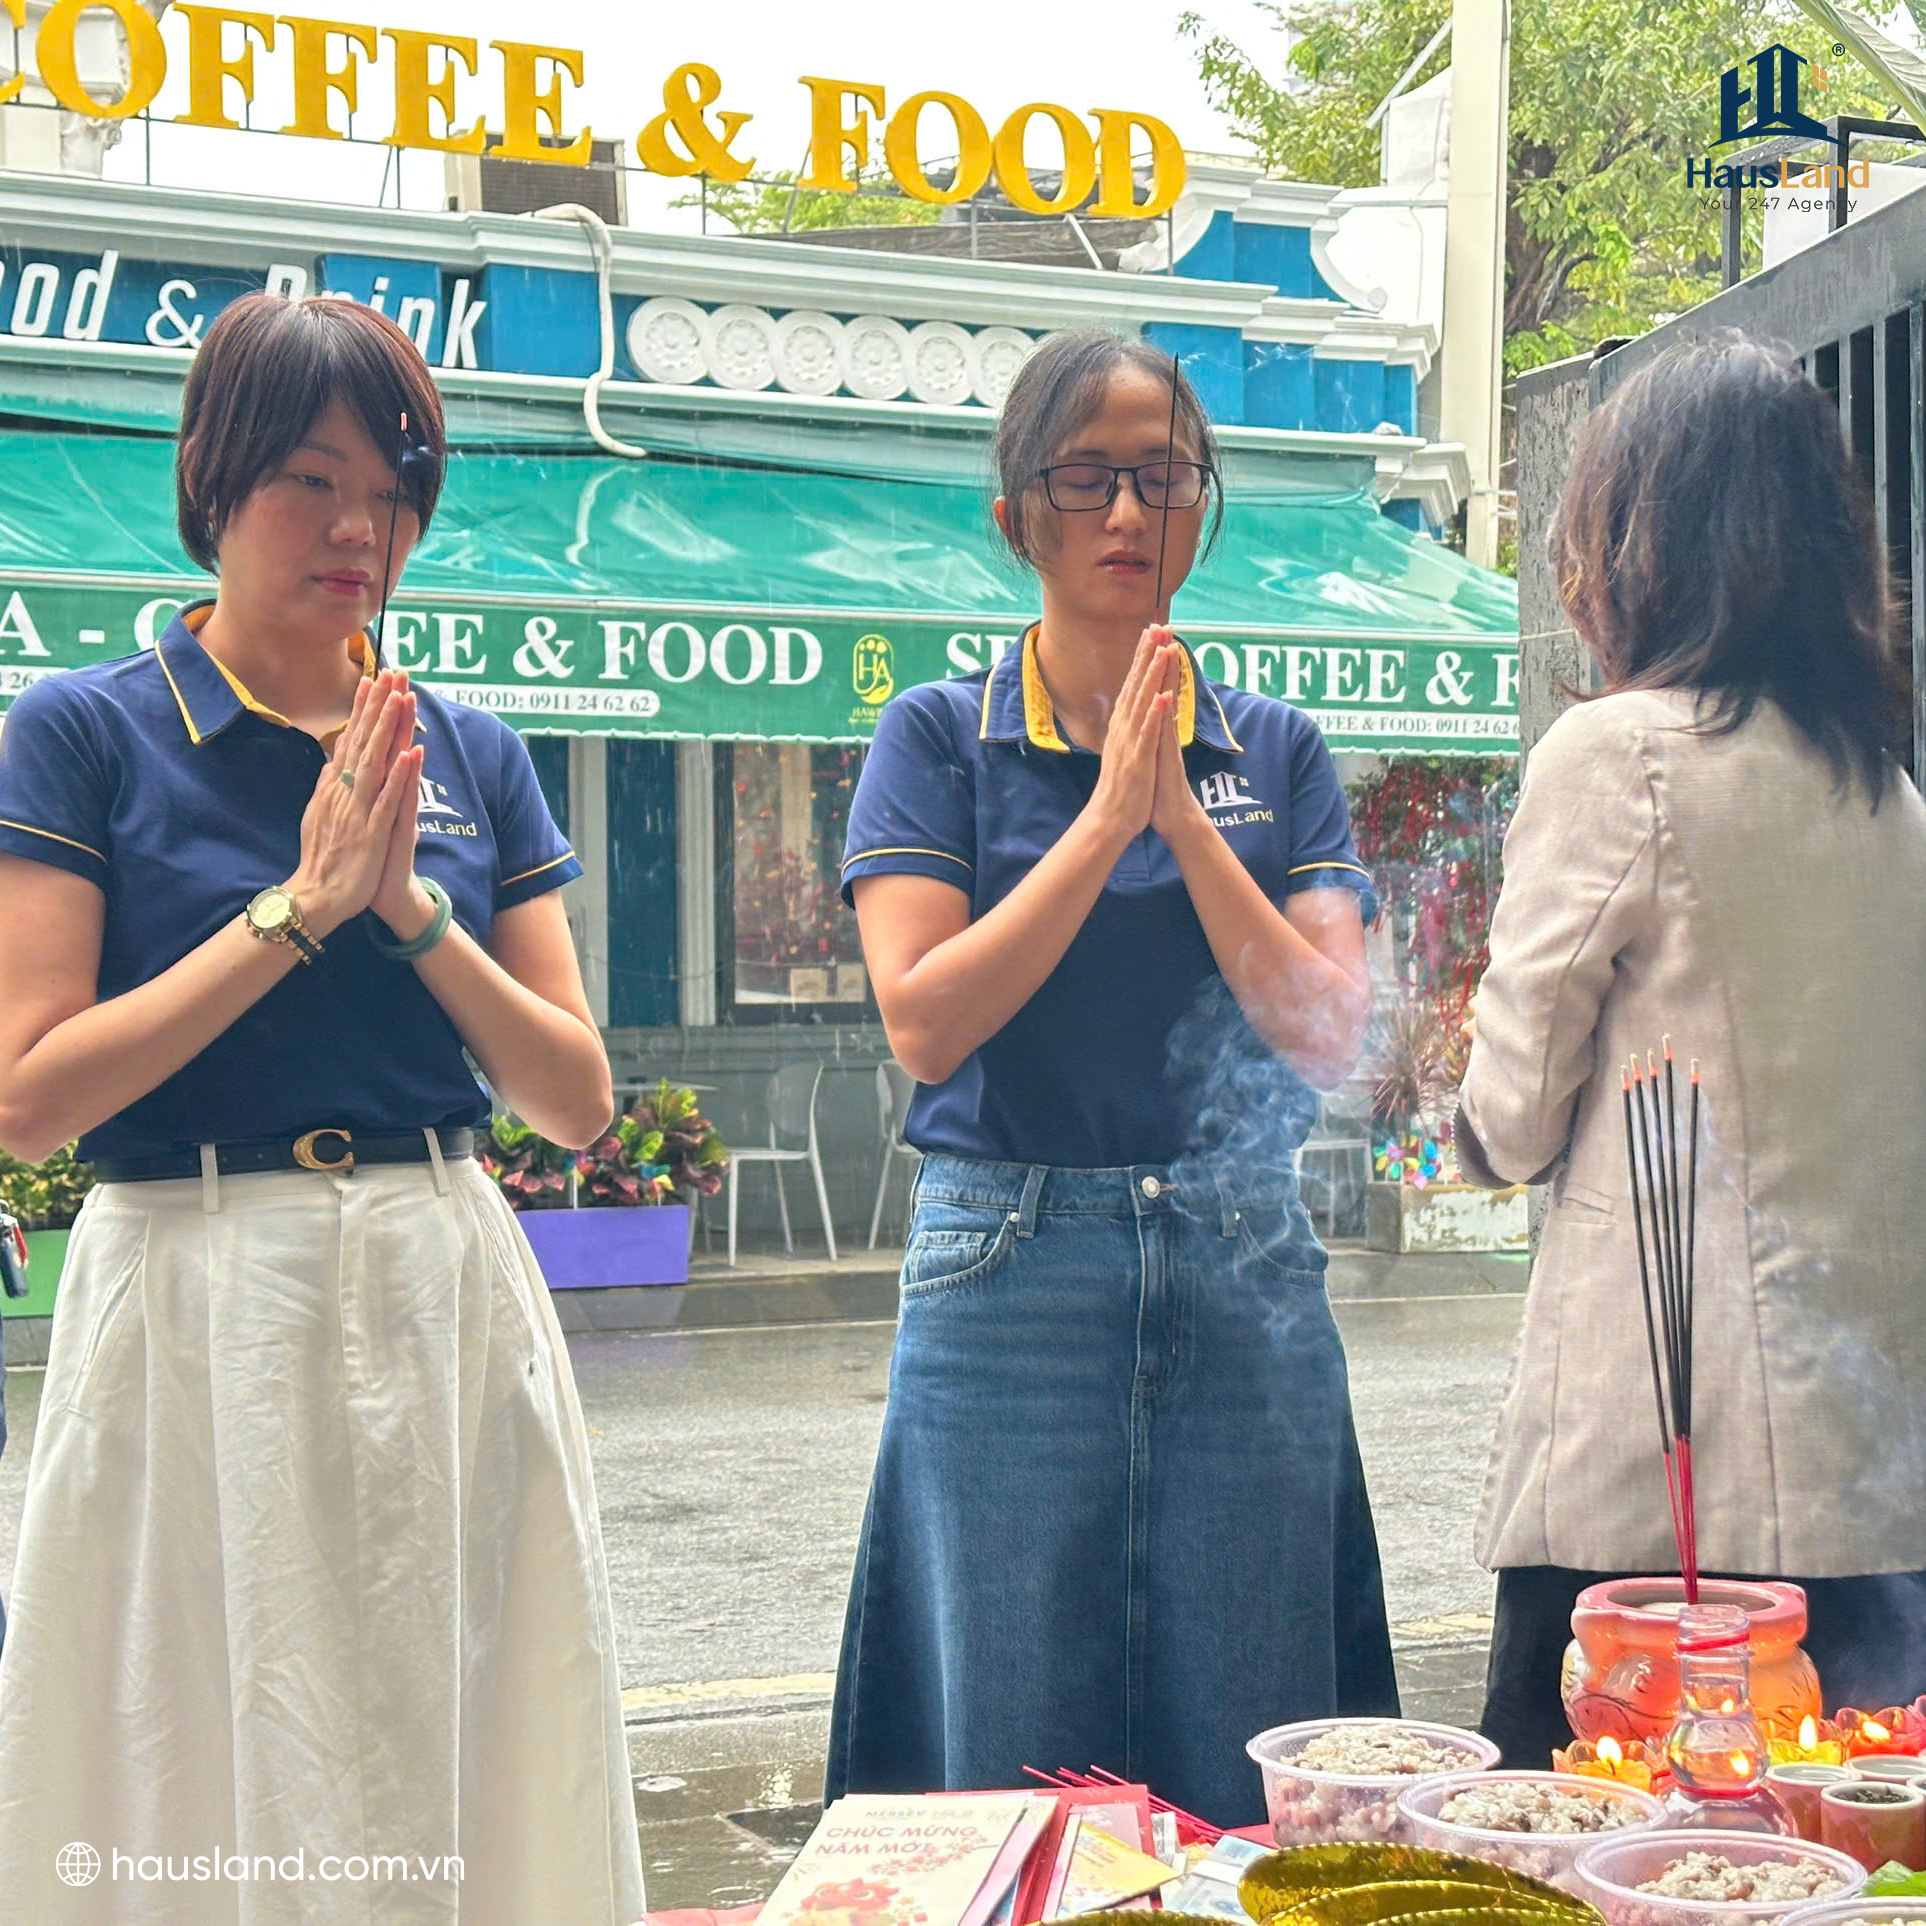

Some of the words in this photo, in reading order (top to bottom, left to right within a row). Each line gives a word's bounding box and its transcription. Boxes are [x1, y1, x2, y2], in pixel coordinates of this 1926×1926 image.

[0, 0, 592, 166] OFFEE
[636, 62, 756, 182] &
[798, 75, 1187, 219] FOOD
[0, 250, 119, 341] od
[146, 279, 204, 350] &
[512, 616, 575, 679] &
[598, 620, 822, 686] FOOD
[1190, 642, 1407, 703] OFFEE
[1425, 651, 1474, 706] &
[456, 690, 523, 710] FOOD:
[530, 693, 570, 709] 0911
[577, 695, 597, 711] 24
[604, 696, 624, 712] 62
[630, 697, 650, 713] 62
[1316, 715, 1358, 730] FFEE
[1362, 718, 1377, 731] &
[1380, 717, 1432, 733] FOOD:
[1436, 719, 1467, 734] 0911
[1473, 720, 1489, 734] 24
[1493, 721, 1509, 735] 62
[415, 820, 478, 837] usLand
[1213, 809, 1274, 827] usLand
